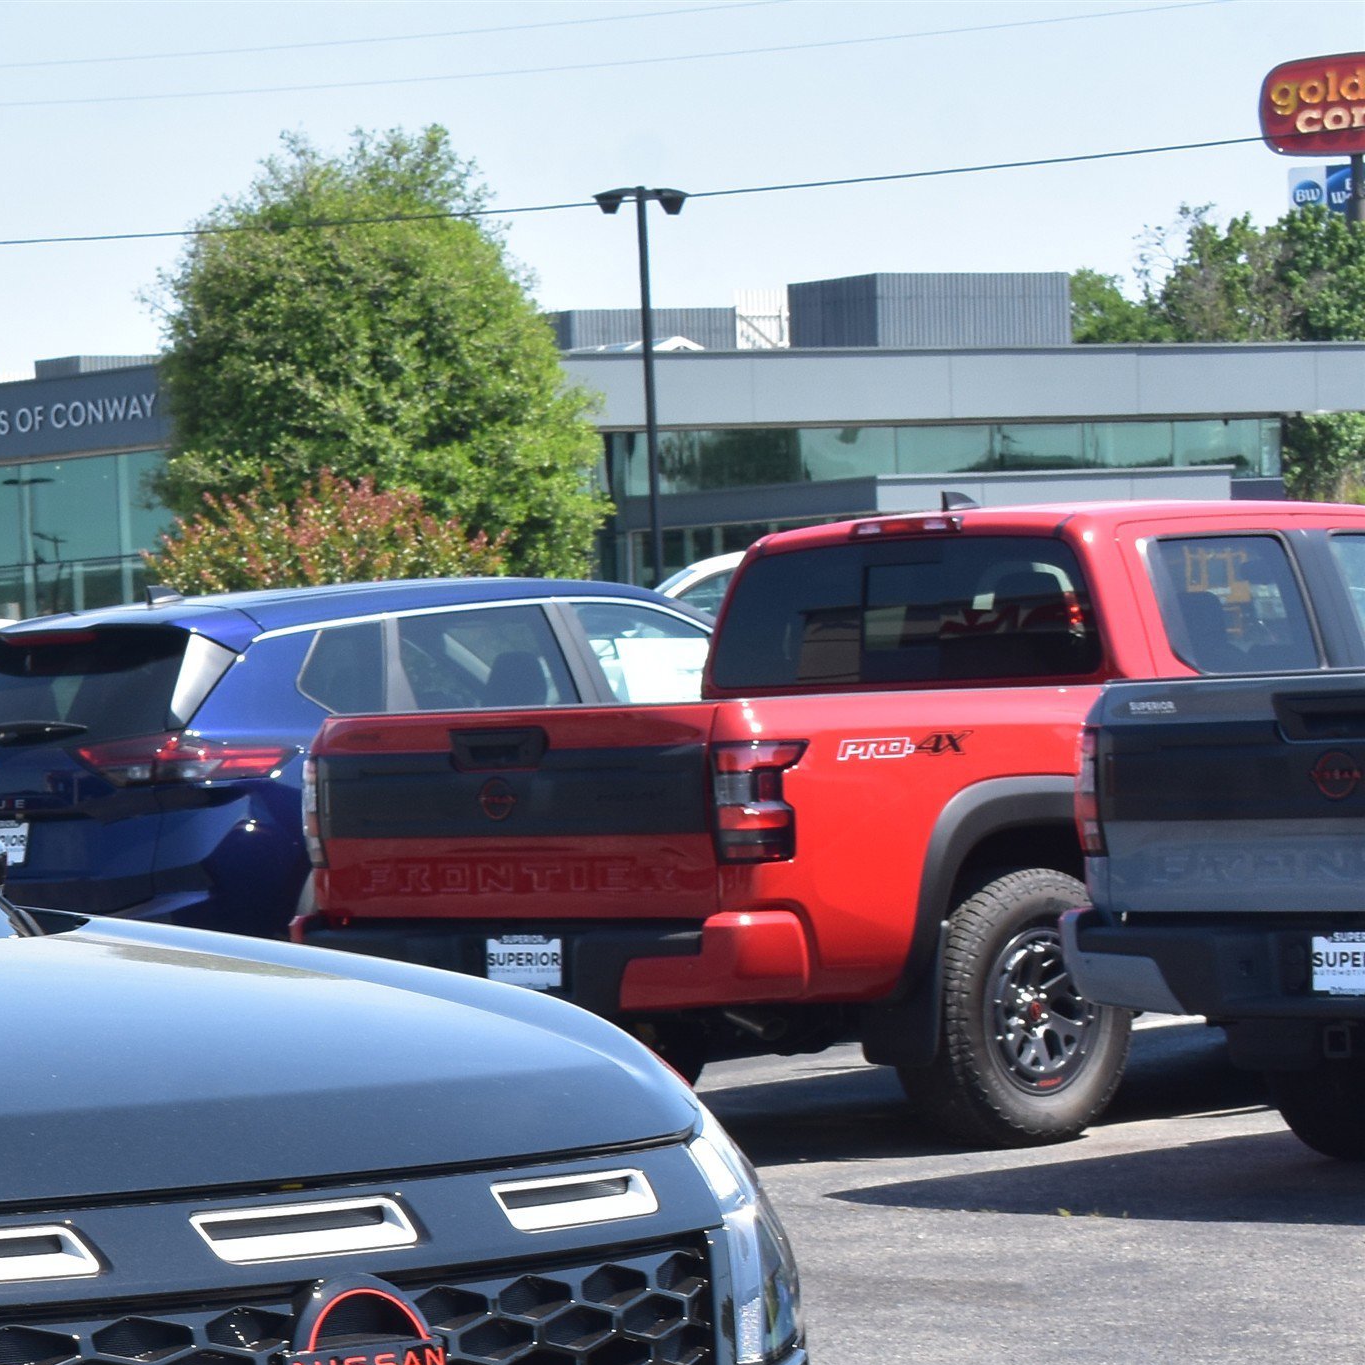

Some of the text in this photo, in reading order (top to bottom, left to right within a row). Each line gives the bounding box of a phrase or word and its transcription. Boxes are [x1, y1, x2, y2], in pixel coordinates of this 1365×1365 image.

[16, 405, 44, 433] OF
[50, 394, 156, 429] CONWAY
[1129, 700, 1175, 710] SUPERIOR
[361, 862, 678, 893] FRONTIER
[487, 951, 562, 966] SUPERIOR
[1313, 951, 1365, 968] SUPE
